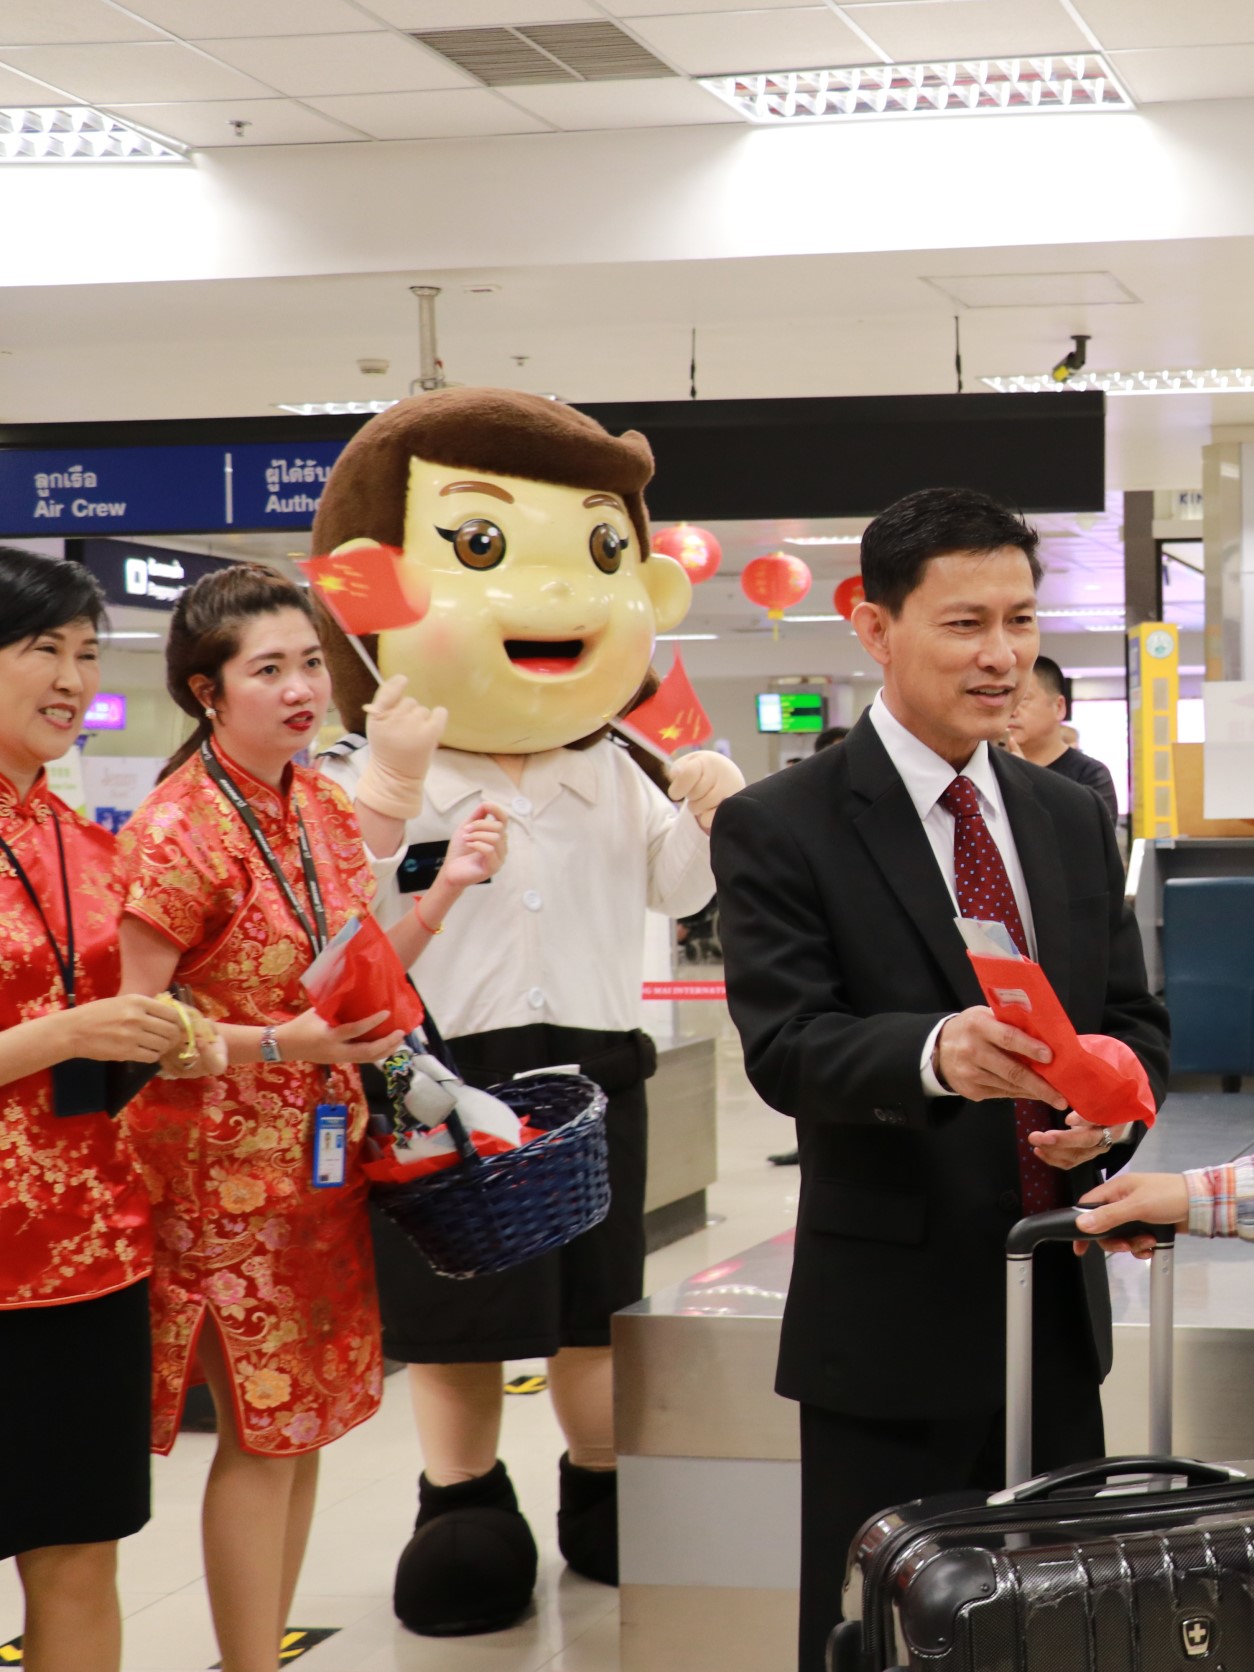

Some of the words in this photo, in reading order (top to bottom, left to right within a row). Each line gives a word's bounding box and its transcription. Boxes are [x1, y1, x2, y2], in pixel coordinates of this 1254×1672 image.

[34, 465, 97, 497] ลูกเรือ
[33, 499, 64, 518] Air
[71, 499, 127, 518] Crew
